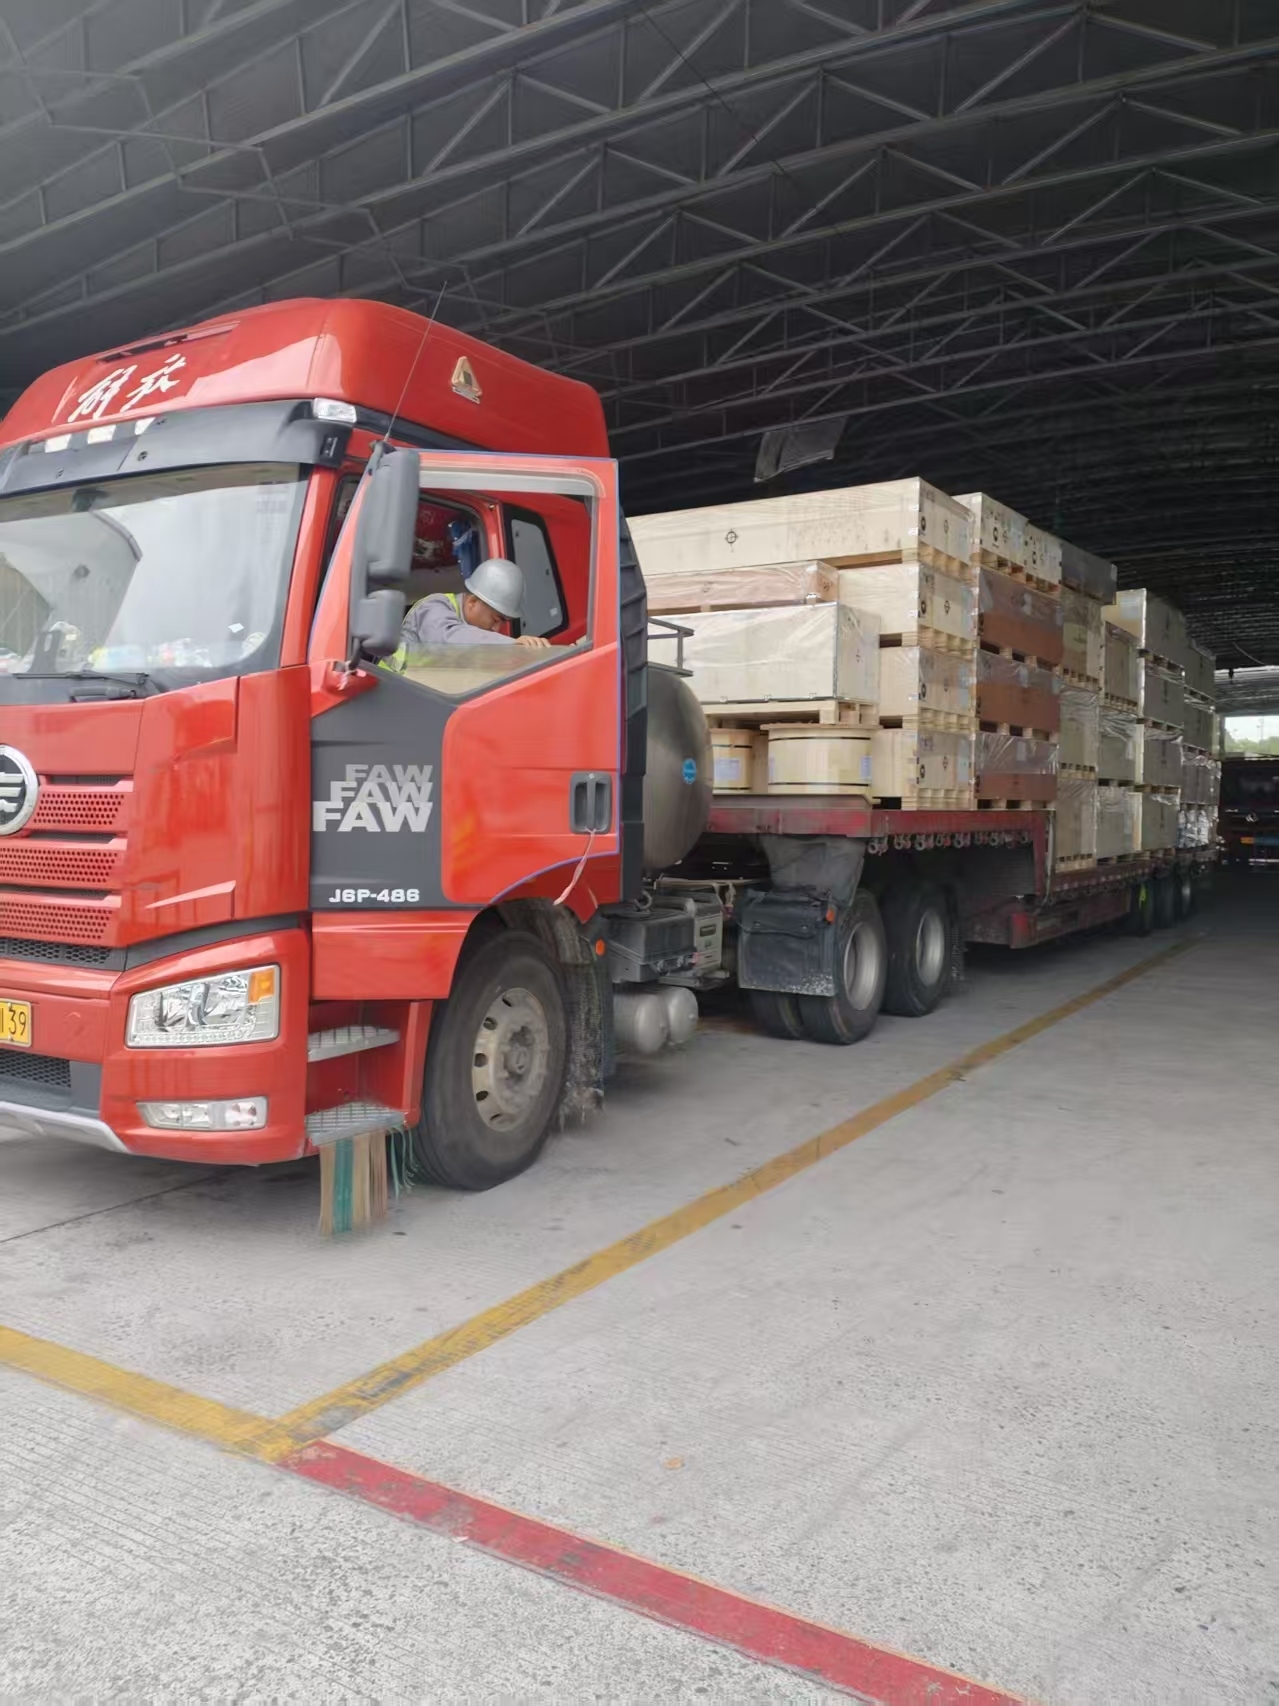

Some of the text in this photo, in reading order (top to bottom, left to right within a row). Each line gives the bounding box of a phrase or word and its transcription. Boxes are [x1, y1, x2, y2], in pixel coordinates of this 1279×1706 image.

[345, 764, 434, 786] FAW
[330, 781, 434, 807] FAW
[312, 801, 434, 833] FAW
